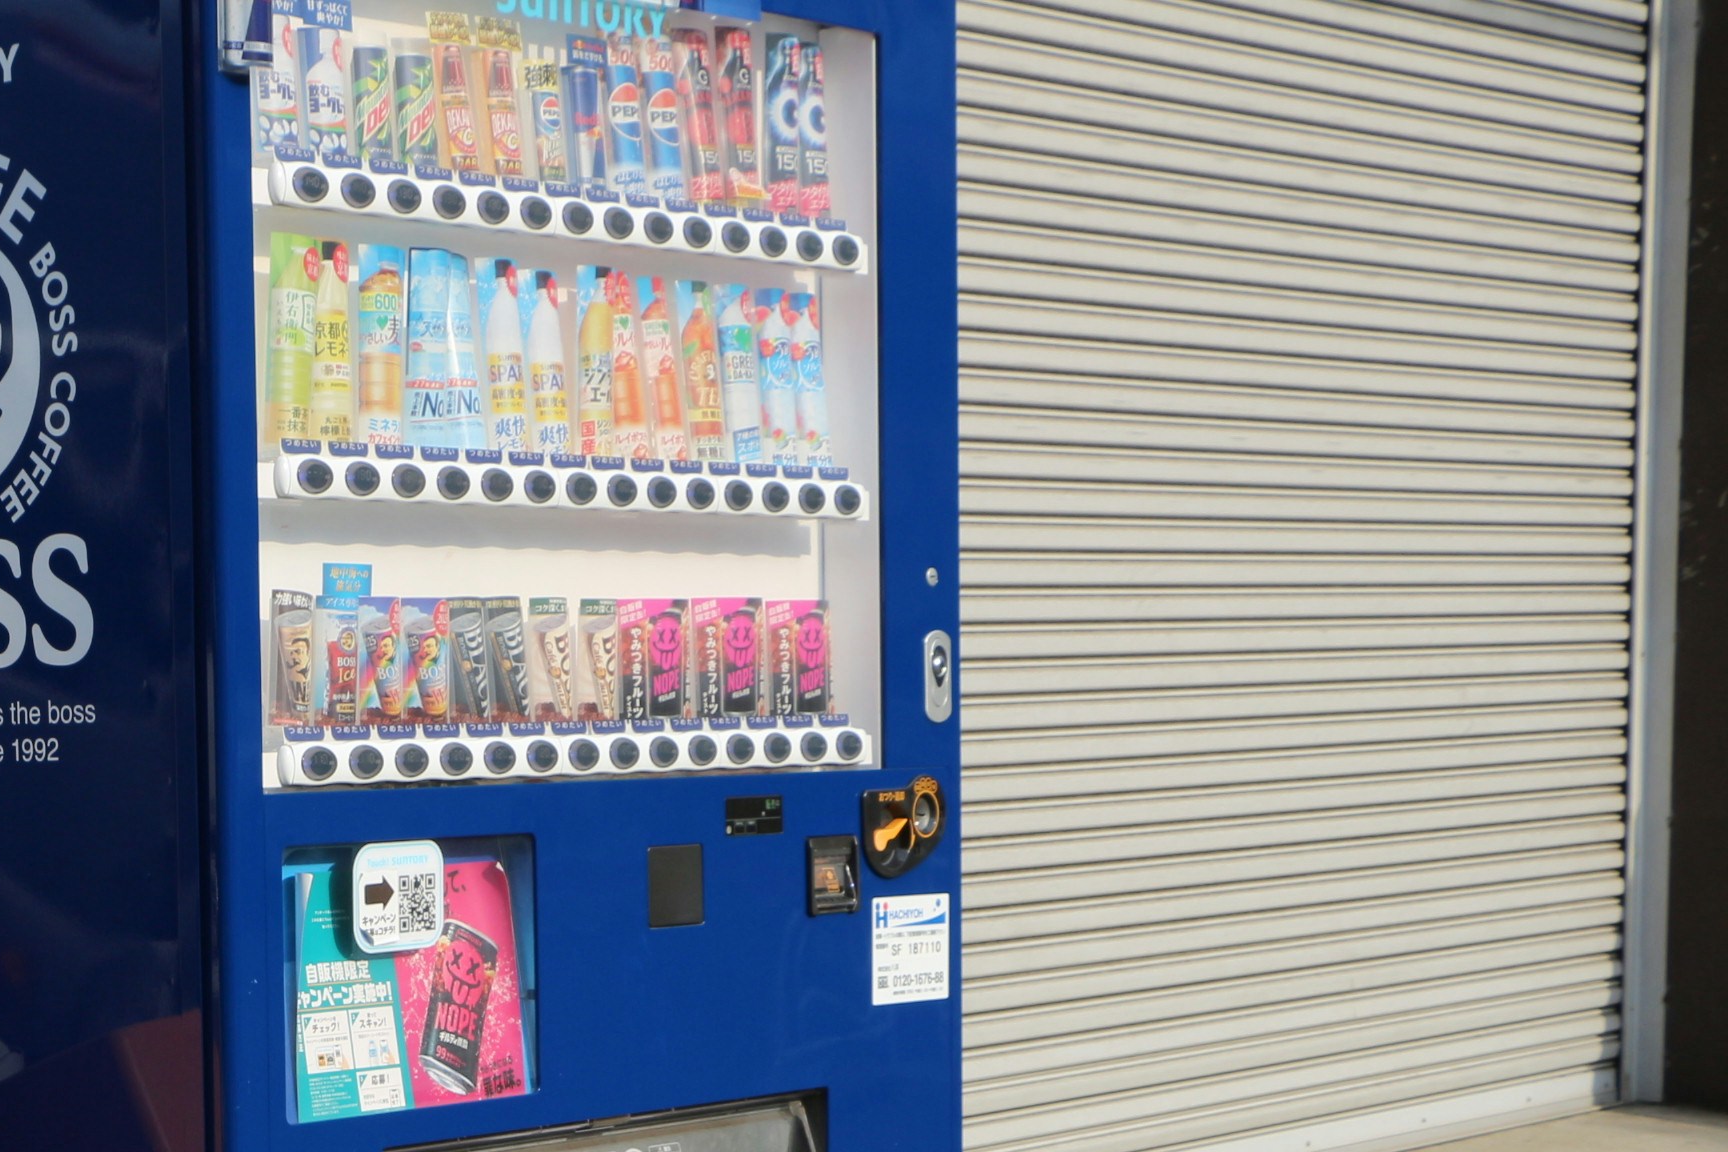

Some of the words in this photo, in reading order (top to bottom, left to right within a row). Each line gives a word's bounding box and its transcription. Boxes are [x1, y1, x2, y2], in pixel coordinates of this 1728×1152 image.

[29, 242, 78, 356] BOSS
[0, 371, 77, 523] COFFEE
[285, 439, 318, 449] つめたい
[332, 442, 365, 451] つめたい
[378, 444, 411, 454] つめたい
[424, 448, 456, 457] つめたい
[468, 450, 500, 459] つめたい
[511, 452, 542, 461] つめたい
[630, 627, 644, 719] やみつきフルーツ
[705, 626, 719, 715] やみつきフルーツ
[778, 628, 792, 715] やみつきフルーツ
[653, 669, 681, 697] NOPE
[727, 666, 754, 693] NOPE
[799, 667, 825, 694] NOPE
[9, 701, 41, 725] the
[47, 700, 96, 725] boss
[511, 722, 542, 730] つめたい
[554, 721, 583, 730] つめたい
[594, 720, 623, 729] つめたい
[634, 719, 662, 728] つめたい
[673, 718, 700, 726] つめたい
[288, 726, 320, 735] つめたい
[335, 725, 367, 734] つめたい
[381, 725, 413, 733] つめたい
[426, 723, 457, 732] つめたい
[469, 723, 499, 731] つめたい
[12, 737, 60, 762] 1992
[306, 960, 372, 985] 自販機限定
[434, 1002, 480, 1041] NOPE
